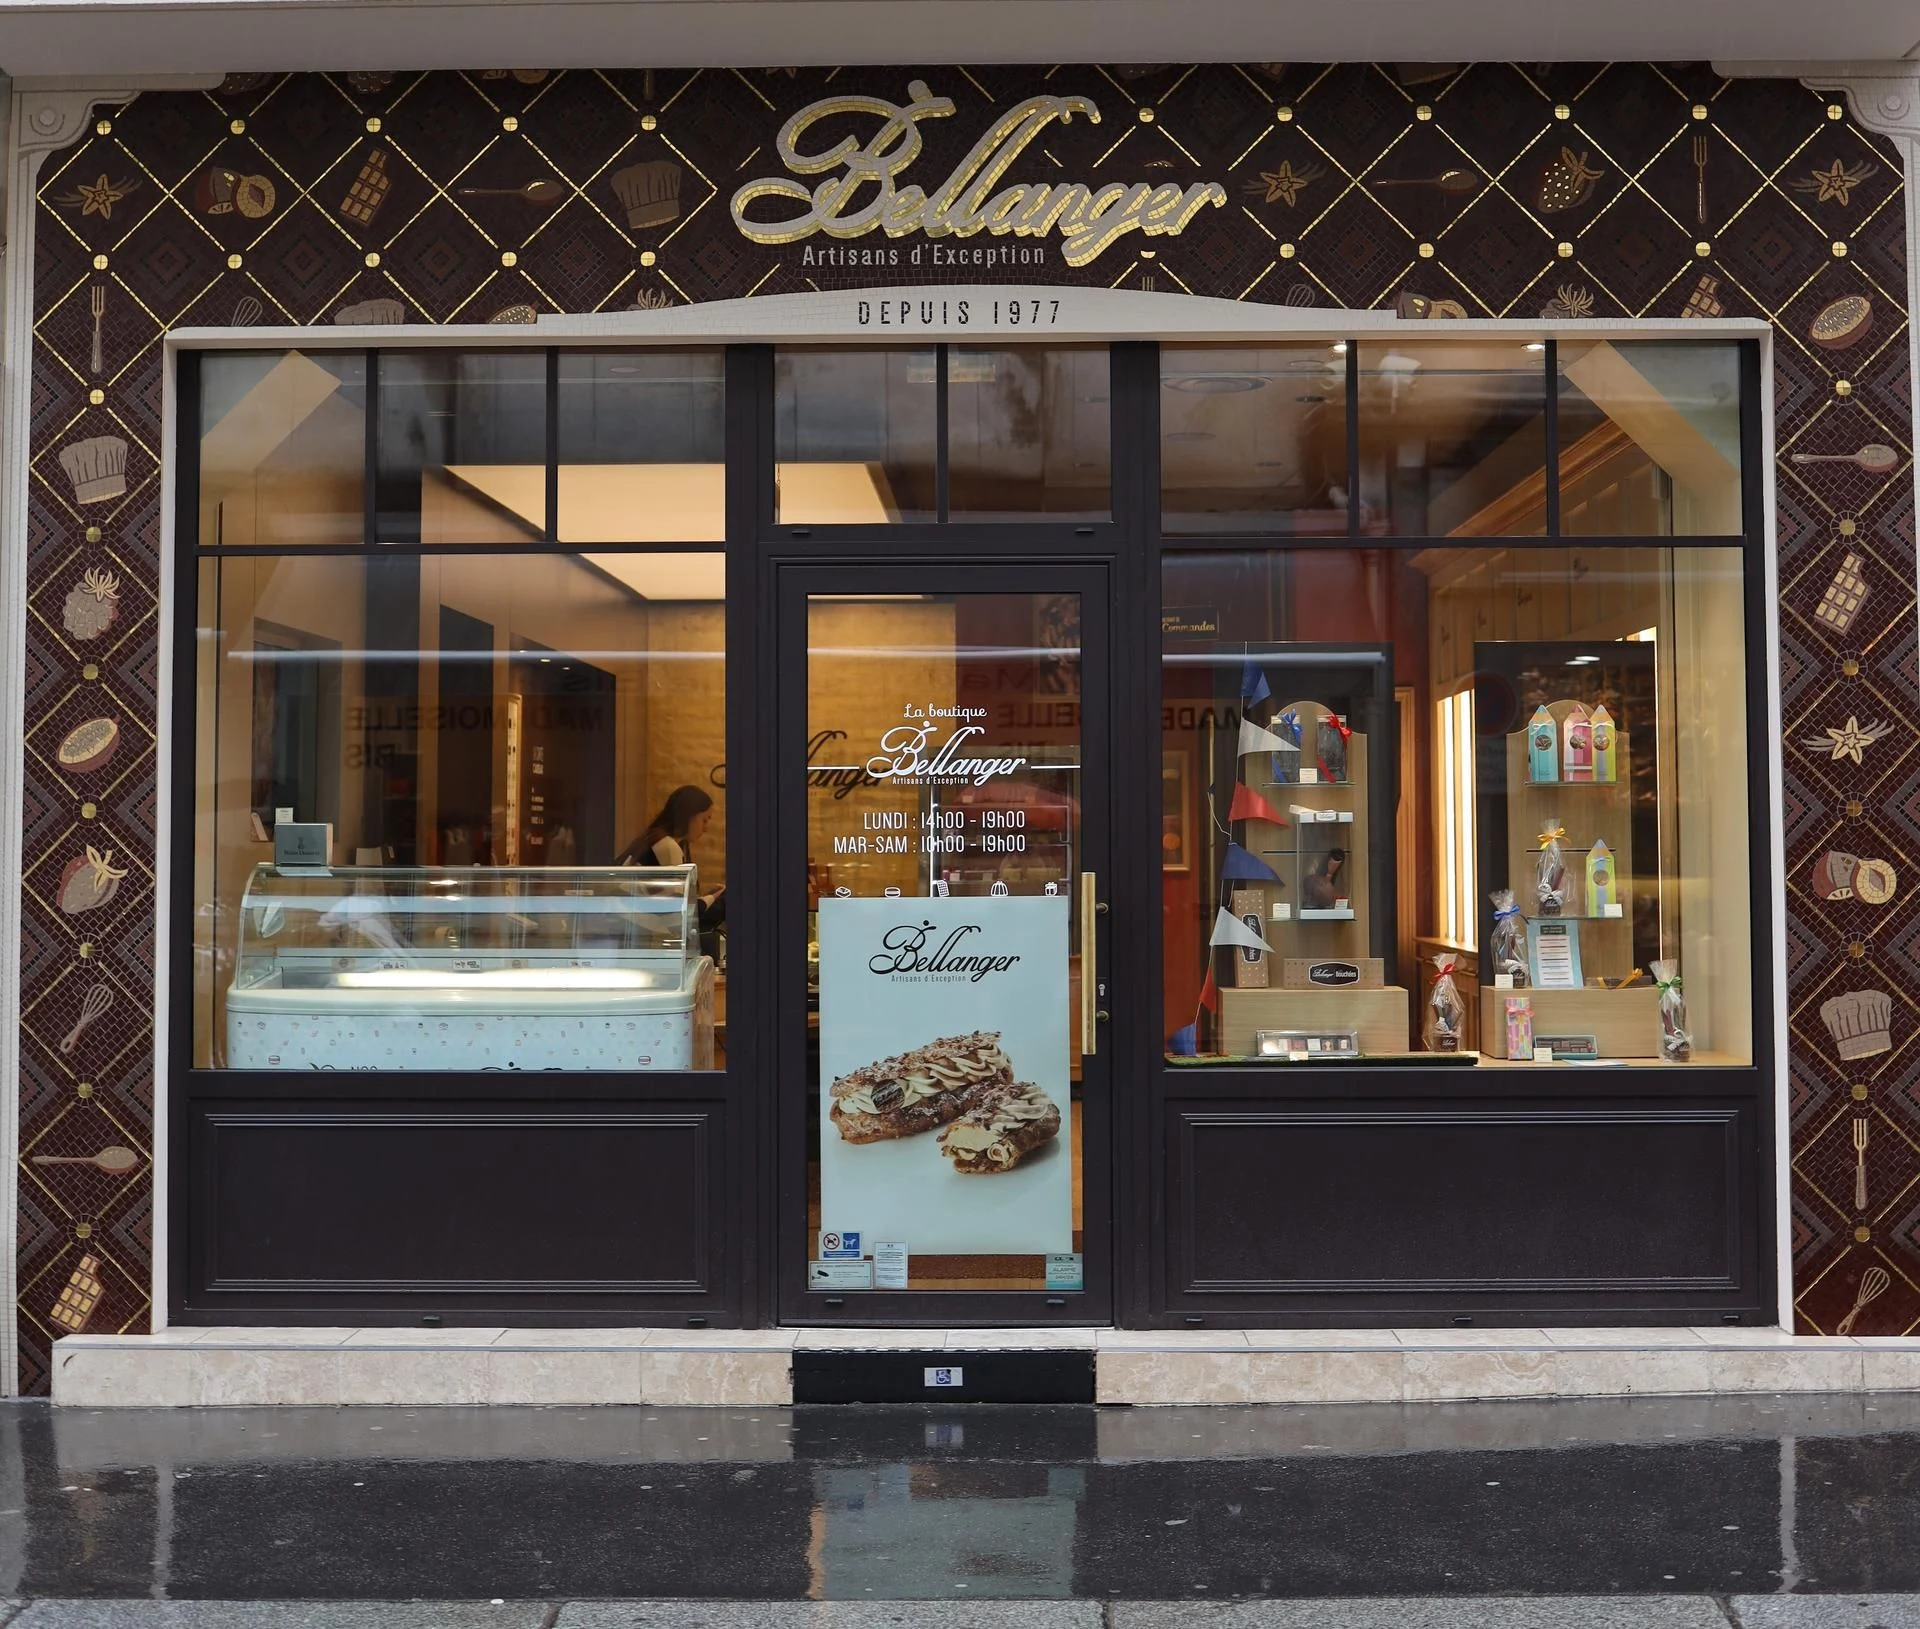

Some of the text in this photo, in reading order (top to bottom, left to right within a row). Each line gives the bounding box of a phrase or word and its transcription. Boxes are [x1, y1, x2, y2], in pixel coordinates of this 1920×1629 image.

[729, 79, 1228, 269] Bellanger
[802, 243, 1046, 269] Artisans d'Exception
[857, 299, 1061, 326] DEPUIS 1977
[903, 703, 988, 722] La boutique
[866, 720, 1027, 787] Bellanger
[892, 776, 969, 786] Artisans d'Exception
[863, 812, 908, 830] LUNDI
[921, 811, 965, 829] 14h00
[982, 810, 1026, 829] 19h00
[834, 836, 908, 854] MAR-SAM
[921, 835, 965, 853] 10h00
[982, 834, 1026, 852] 19h00
[868, 919, 1021, 983] Bellanger
[891, 974, 922, 983] Artisans
